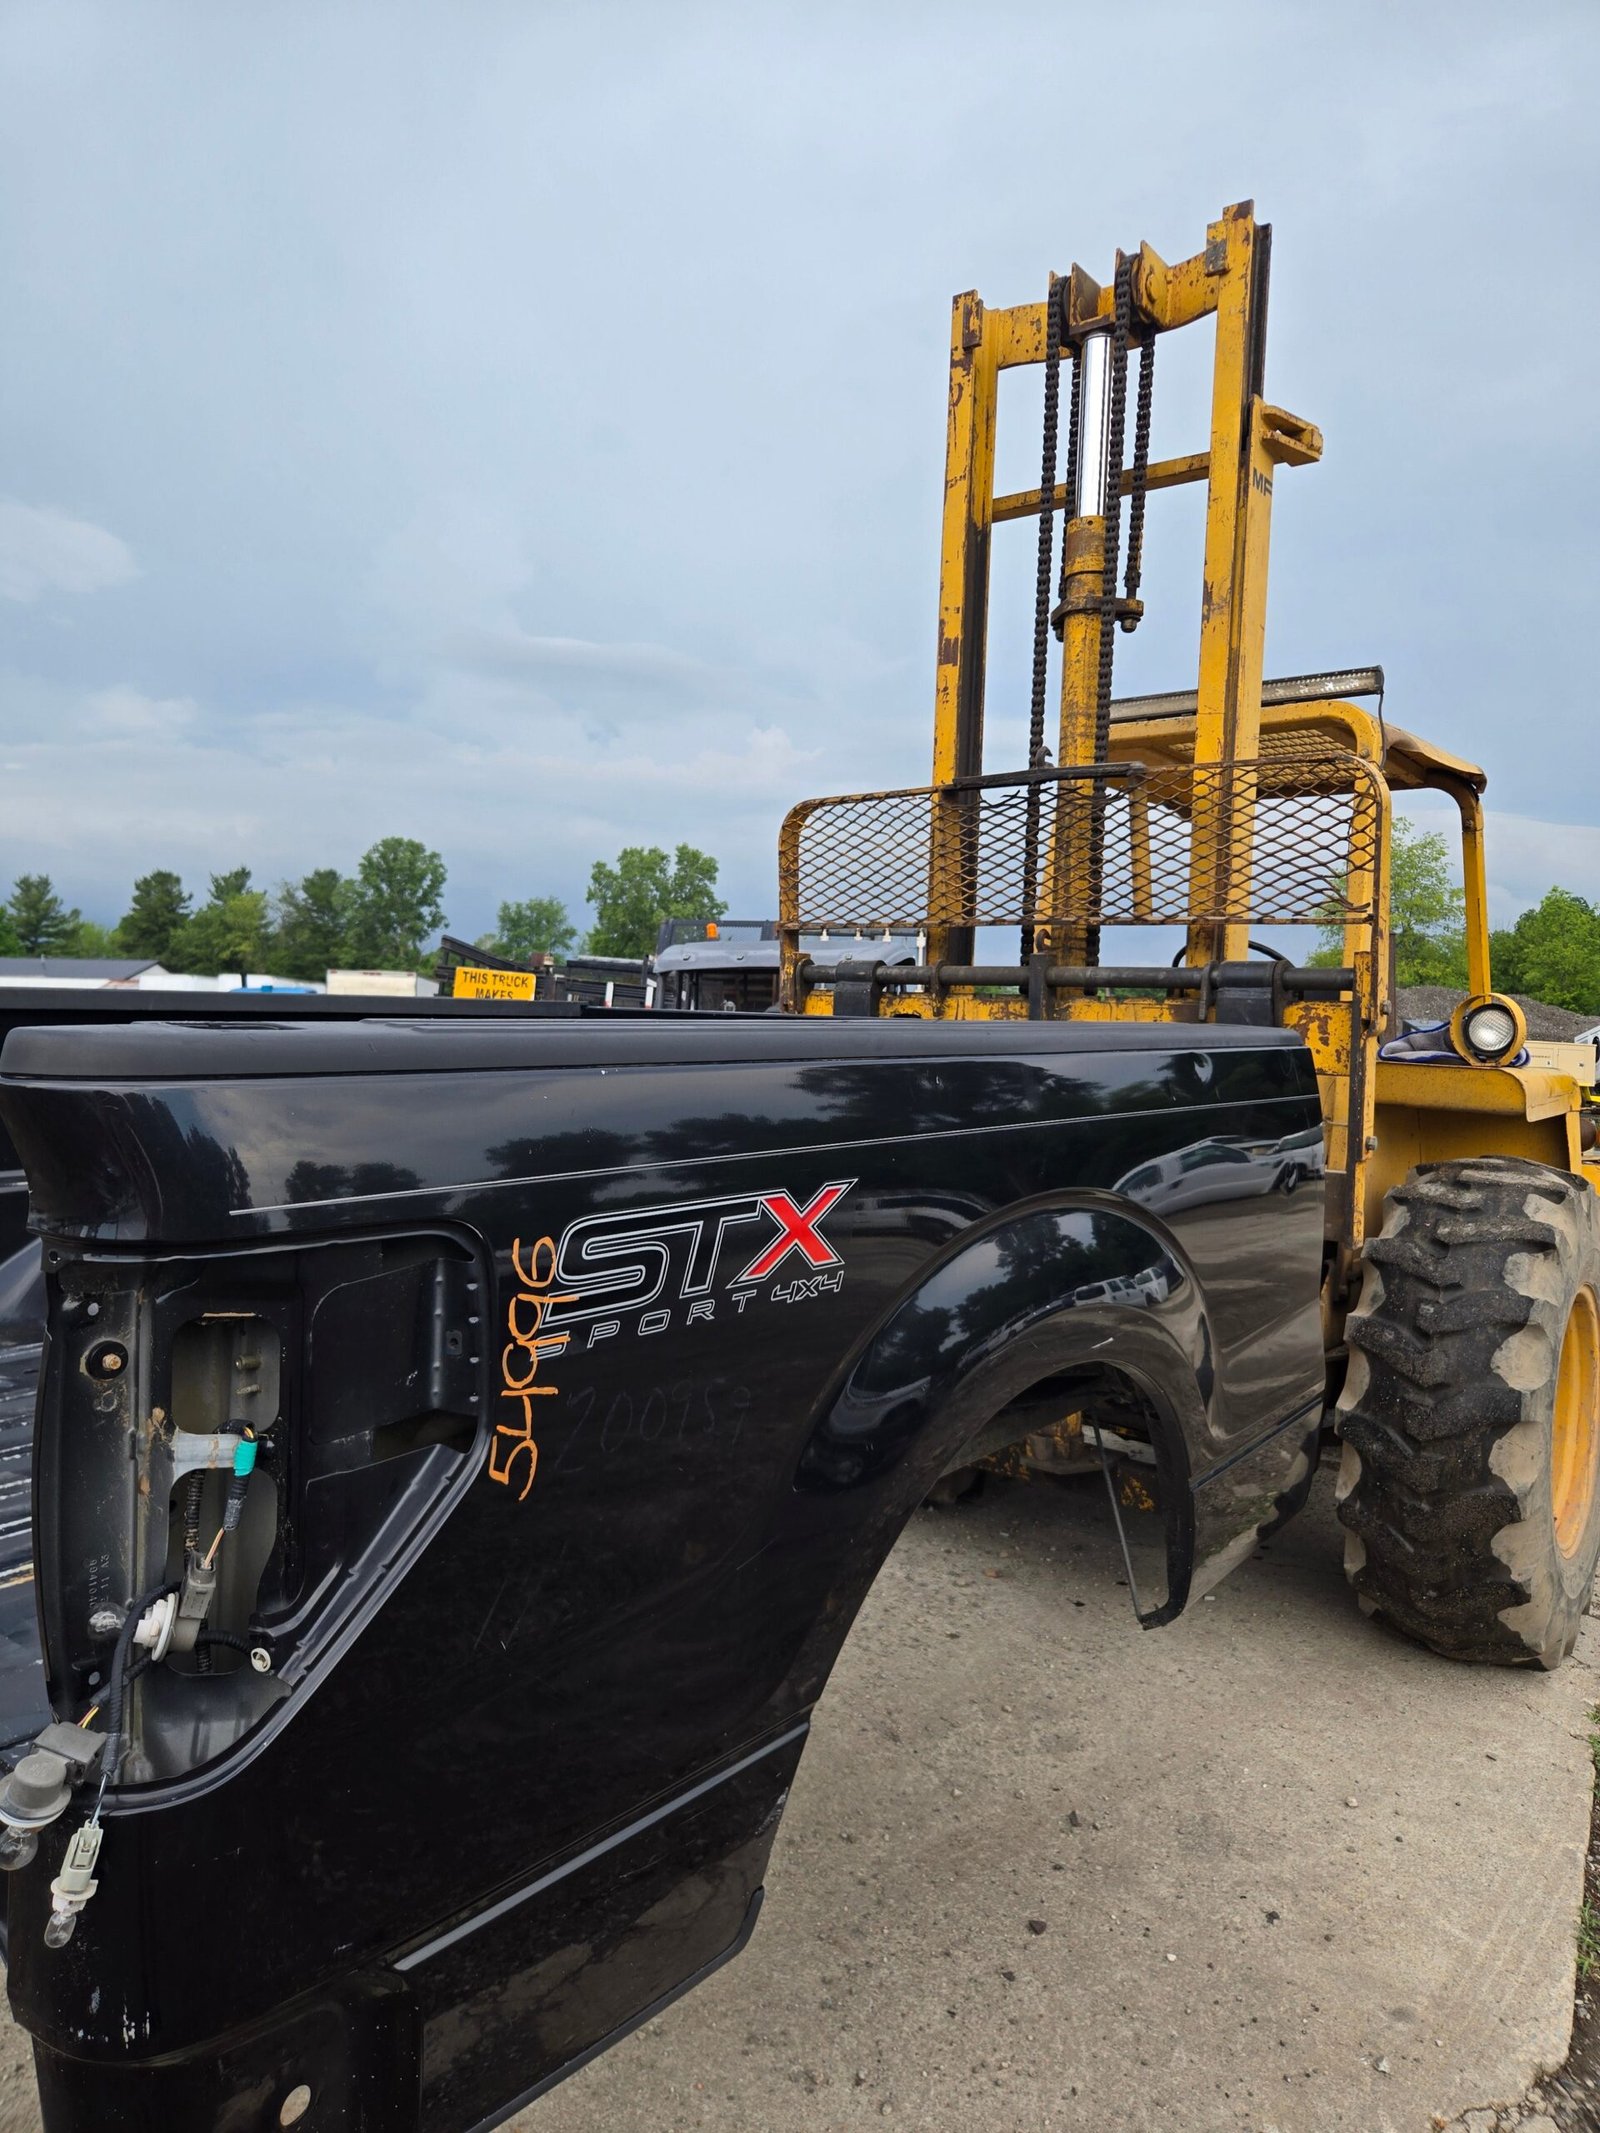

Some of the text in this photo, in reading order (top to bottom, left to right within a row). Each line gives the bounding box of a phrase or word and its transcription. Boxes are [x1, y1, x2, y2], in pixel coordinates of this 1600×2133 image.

[463, 971, 529, 988] THIS TRUCK
[475, 987, 514, 999] MAKES
[539, 1178, 858, 1329] STX
[530, 1289, 758, 1362] SPORT
